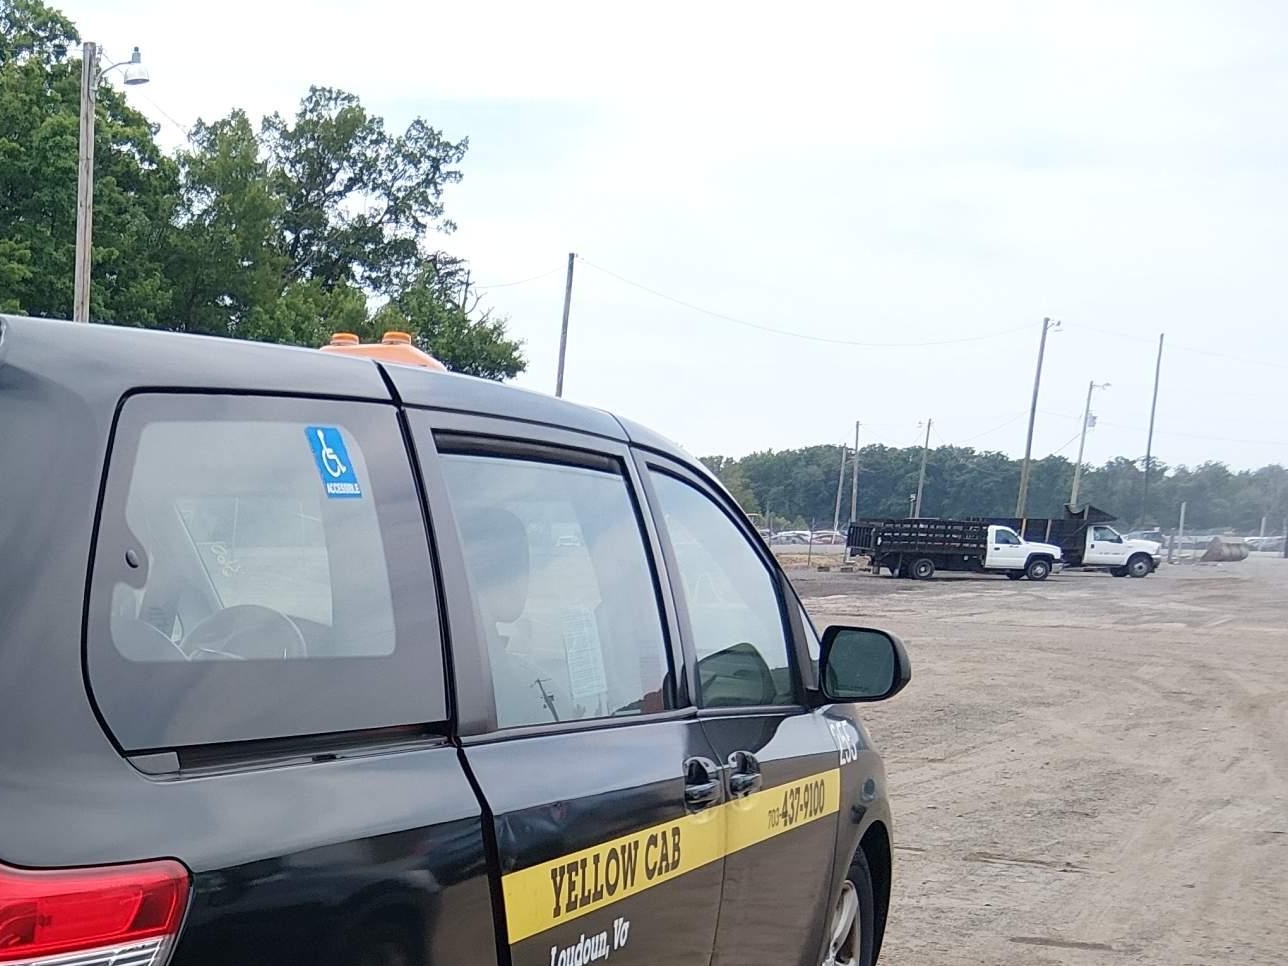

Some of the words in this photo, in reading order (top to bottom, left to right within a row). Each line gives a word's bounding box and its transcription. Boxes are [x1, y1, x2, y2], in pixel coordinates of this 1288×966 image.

[829, 719, 858, 766] 255
[768, 779, 825, 829] 703-437-9100
[550, 840, 640, 919] YELLOW
[644, 826, 681, 881] CAB
